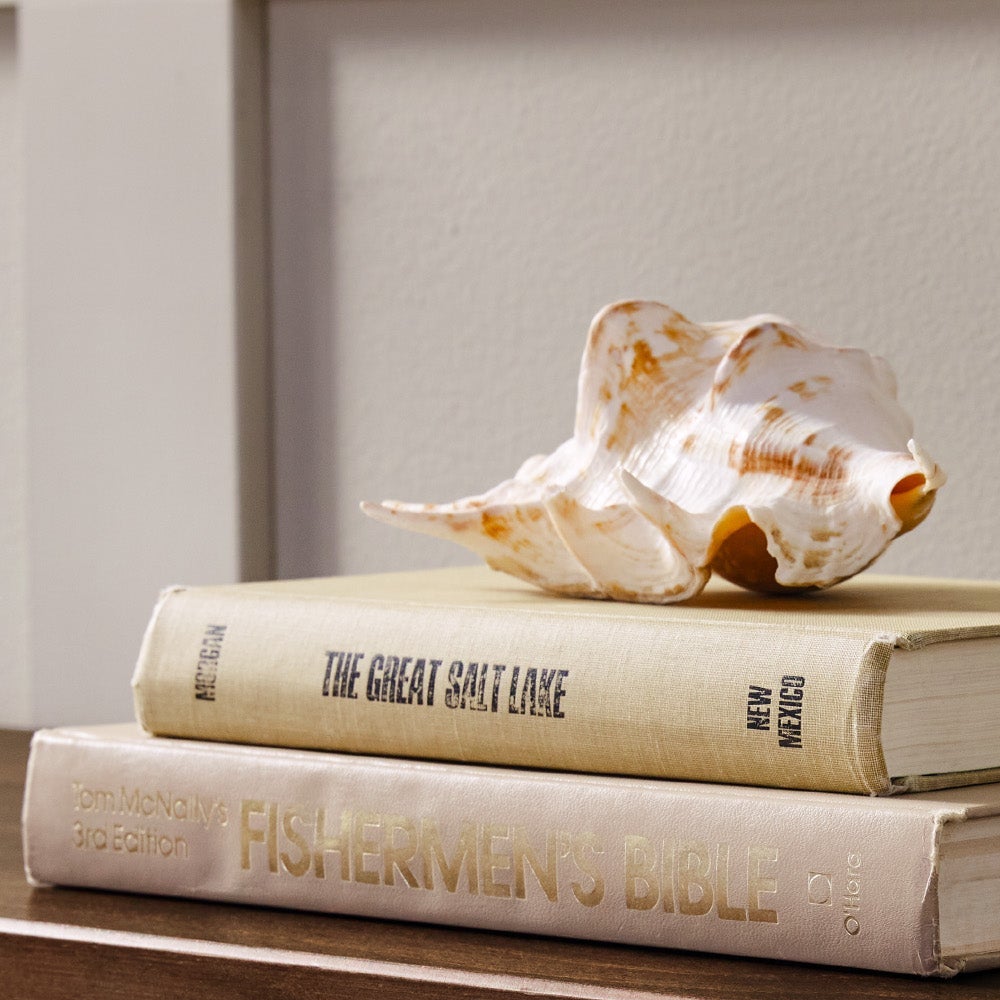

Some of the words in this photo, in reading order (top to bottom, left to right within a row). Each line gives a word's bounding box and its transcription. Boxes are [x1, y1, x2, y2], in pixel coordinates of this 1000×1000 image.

[195, 624, 227, 701] MORGAN
[322, 650, 364, 699] THE
[366, 653, 442, 706] GREAT
[445, 660, 506, 712] SALT
[508, 665, 569, 718] LAKE
[747, 685, 772, 731] NEW
[778, 675, 805, 749] MEXICO
[72, 781, 114, 814] Tom
[73, 820, 107, 851] 3rd
[112, 824, 189, 858] Edition
[240, 798, 605, 908] FISHERMEN'S
[624, 835, 780, 924] BIBLE
